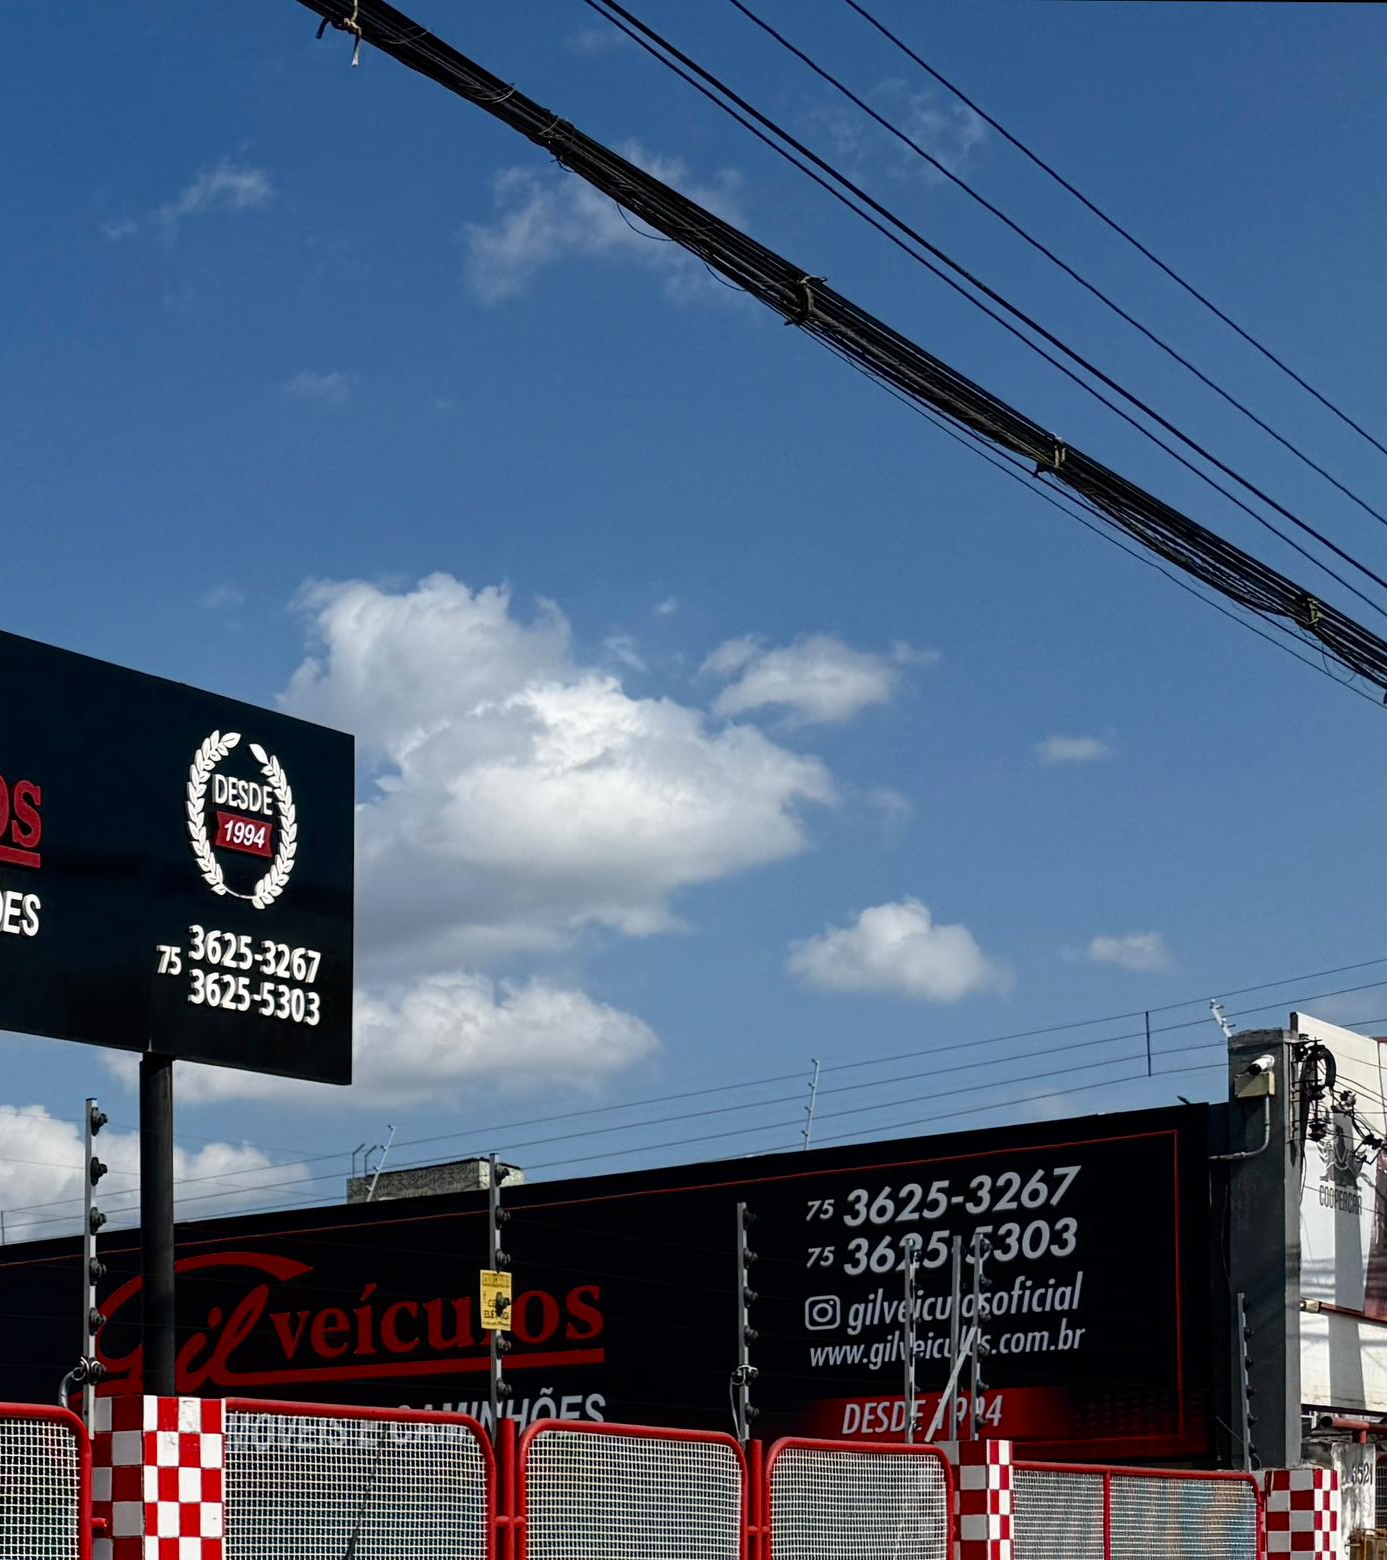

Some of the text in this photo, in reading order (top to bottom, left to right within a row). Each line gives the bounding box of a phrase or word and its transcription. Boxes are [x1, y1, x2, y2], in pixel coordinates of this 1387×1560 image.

[212, 773, 273, 815] DESDE
[223, 819, 266, 848] 1994
[156, 924, 322, 983] 75 3625-3267
[187, 968, 321, 1026] 3625-5303
[805, 1165, 1083, 1227] 75 3625-3267
[805, 1246, 835, 1268] 75
